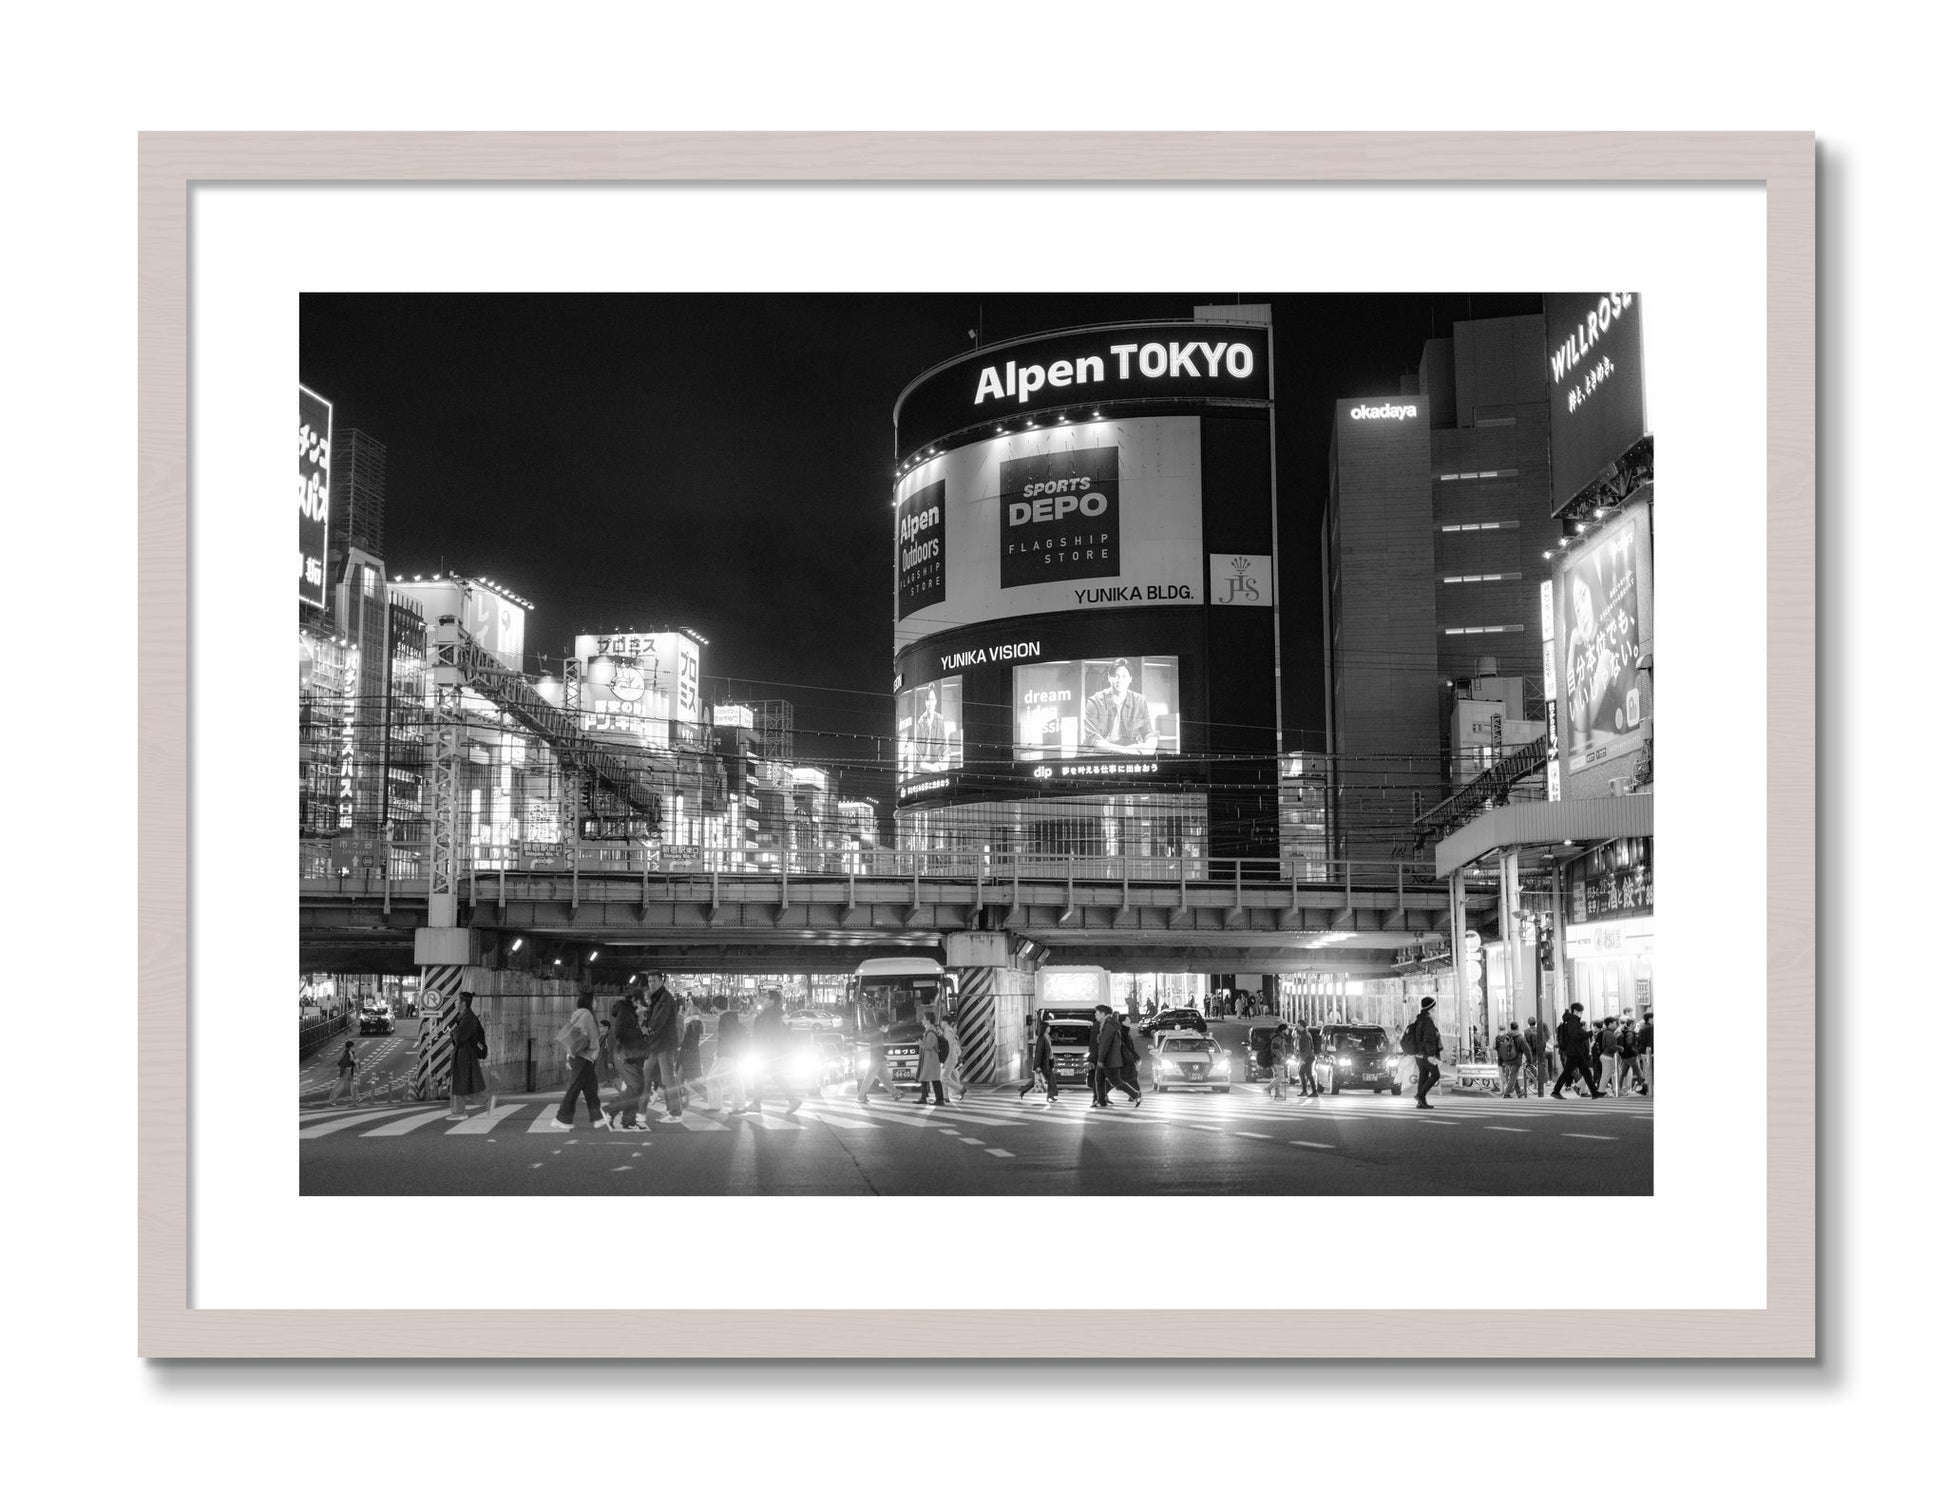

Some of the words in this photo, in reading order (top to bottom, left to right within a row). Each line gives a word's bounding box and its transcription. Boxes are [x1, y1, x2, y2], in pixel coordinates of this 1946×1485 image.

[974, 354, 1104, 405] Alpen
[1110, 341, 1254, 379] TOKYO
[1350, 403, 1417, 421] okadaya
[1023, 476, 1091, 498] SPORTS
[1008, 492, 1108, 527] DEPO
[900, 506, 940, 544] Alpen
[1008, 533, 1109, 554] FLAGSHIP
[902, 538, 939, 572] Outdoors
[1044, 549, 1109, 564] STORE
[900, 562, 940, 591] FLAGSHIP
[911, 576, 940, 596] STORE
[1074, 586, 1143, 604] YUNIKA
[1146, 585, 1195, 601] BLDG.
[597, 636, 656, 654] プロミス
[941, 649, 987, 671] YUNIKA
[988, 641, 1040, 661] VISION
[1024, 689, 1071, 704] dream
[1033, 765, 1053, 779] dip
